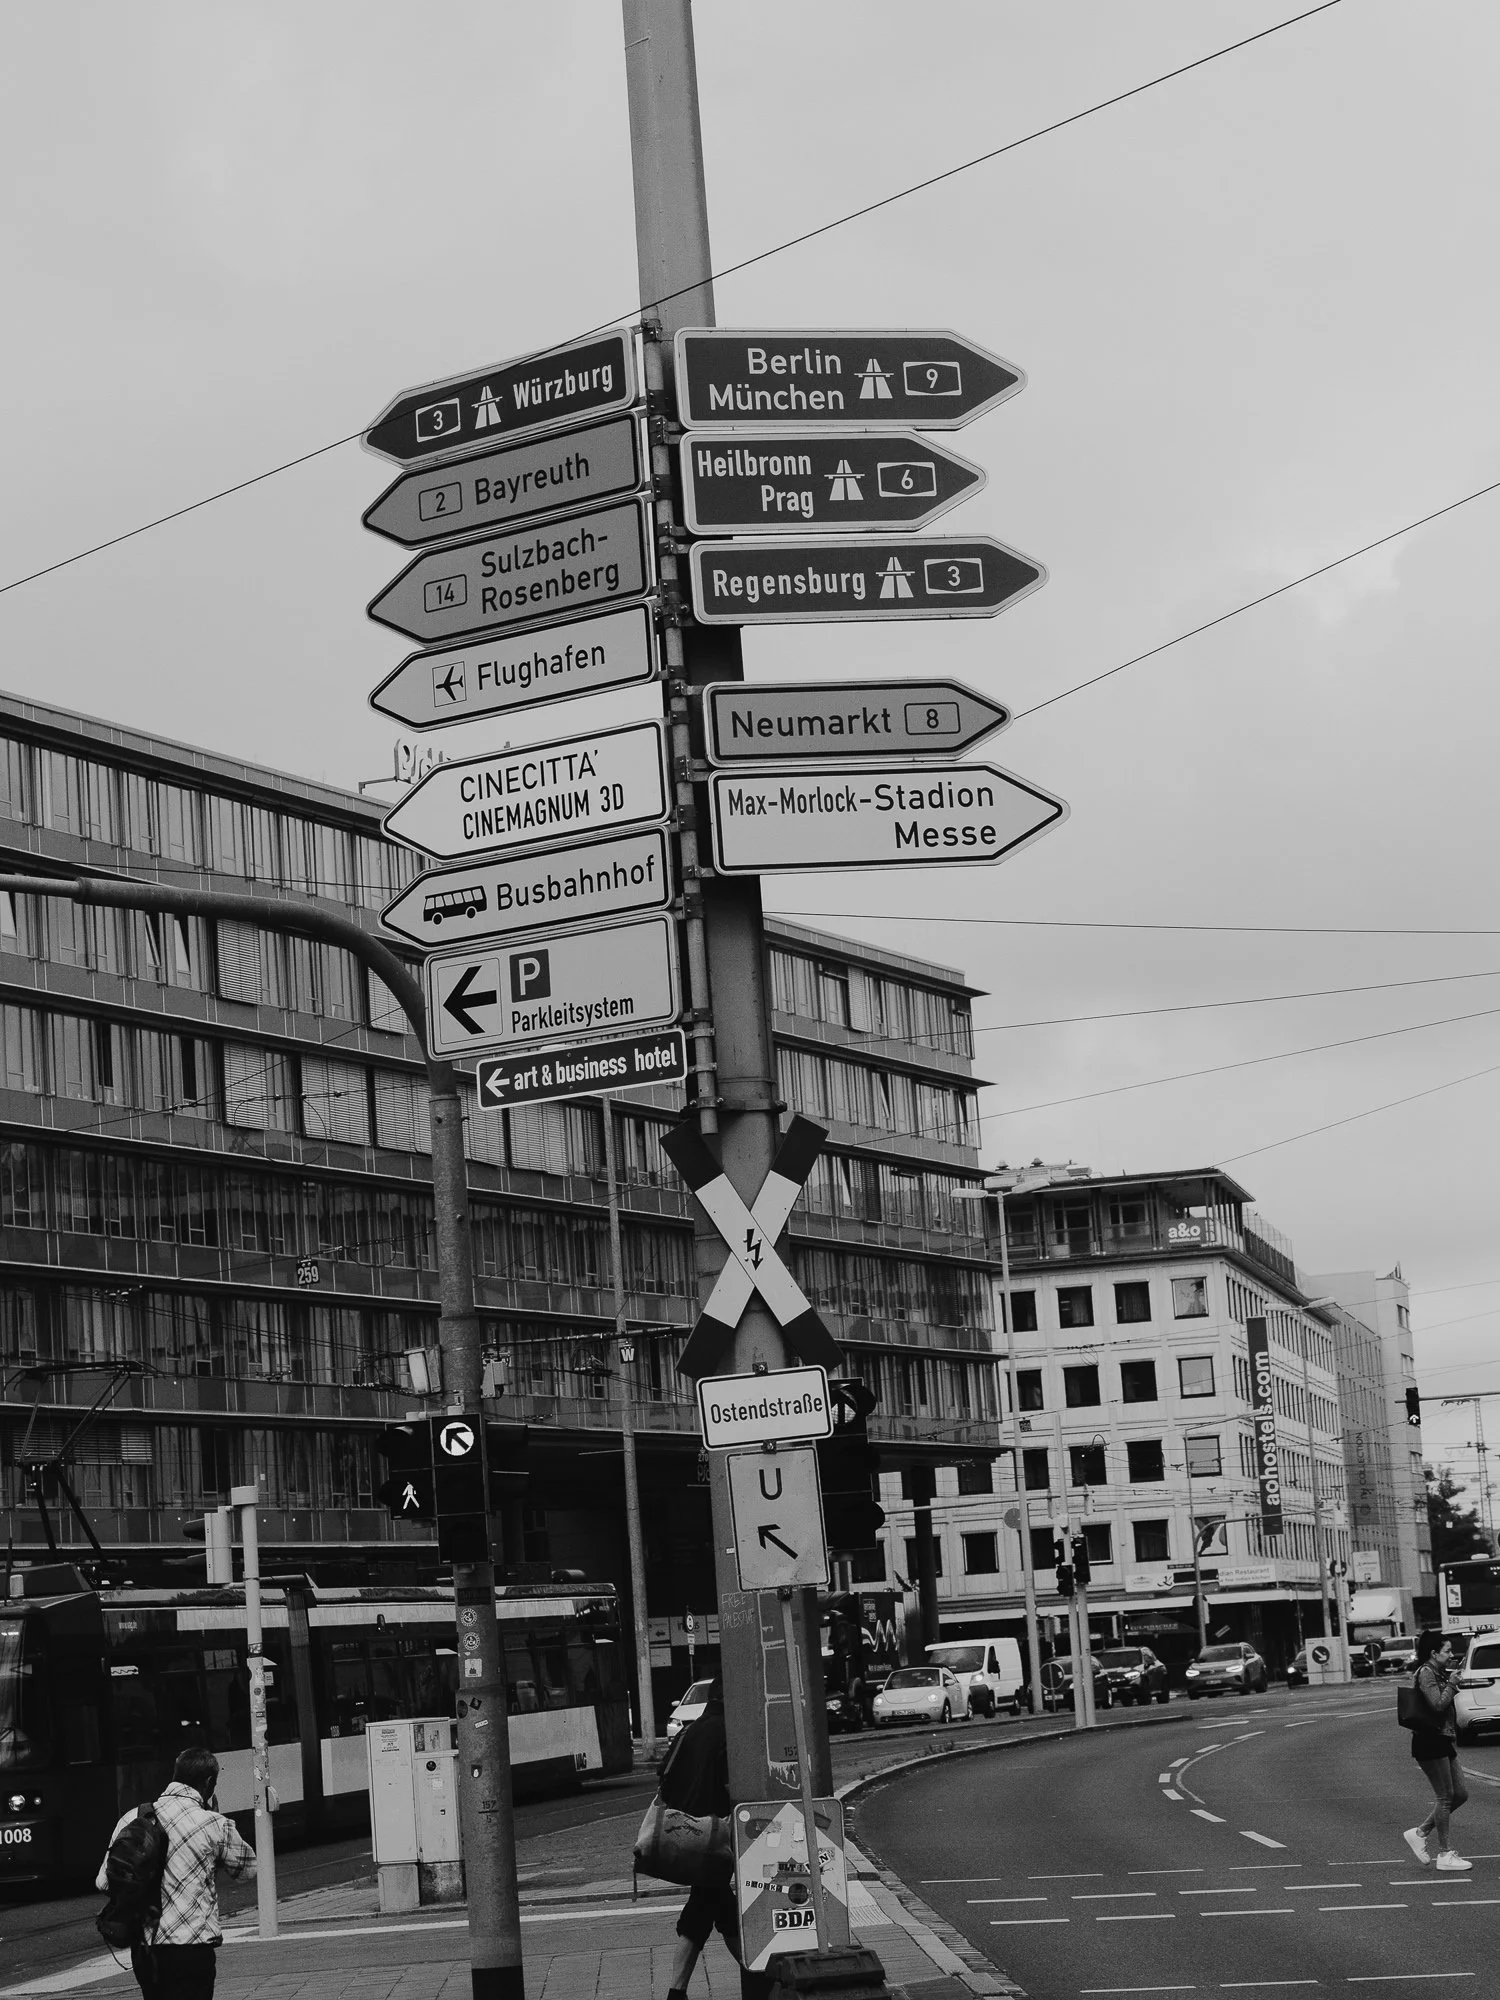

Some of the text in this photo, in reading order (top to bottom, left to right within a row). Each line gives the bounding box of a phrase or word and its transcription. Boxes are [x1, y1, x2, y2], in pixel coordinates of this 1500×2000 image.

[747, 347, 842, 374] Berlin
[926, 368, 938, 389] 9
[433, 362, 614, 430] 3 Würzburg
[708, 383, 845, 411] München
[697, 449, 812, 477] Heilbronn
[901, 469, 914, 490] 6
[435, 453, 590, 512] 2 Bayreuth
[761, 484, 814, 518] Prag
[480, 527, 609, 578] Sulzbach-
[436, 582, 455, 605] 14
[481, 562, 620, 614] Rosenberg
[712, 565, 961, 603] Regensburg 3
[477, 644, 605, 691] Flughafen
[731, 707, 939, 738] Neumarkt 8
[463, 783, 625, 840] CINEMAGNUM 3D
[727, 782, 994, 816] Max-Morlock-Stadion
[894, 821, 997, 848] Messe
[497, 854, 655, 911] Busbahnhof
[518, 957, 541, 996] P
[511, 996, 634, 1034] Parkleitsystem
[514, 1042, 678, 1091] art & business hotel
[1168, 1222, 1201, 1239] a&o
[297, 1265, 319, 1285] 259
[621, 1348, 635, 1362] W
[710, 1393, 823, 1424] Ostendstraße
[1254, 1351, 1281, 1506] aohostels.com
[1355, 1431, 1368, 1486] COLLECTION
[758, 1467, 783, 1501] U
